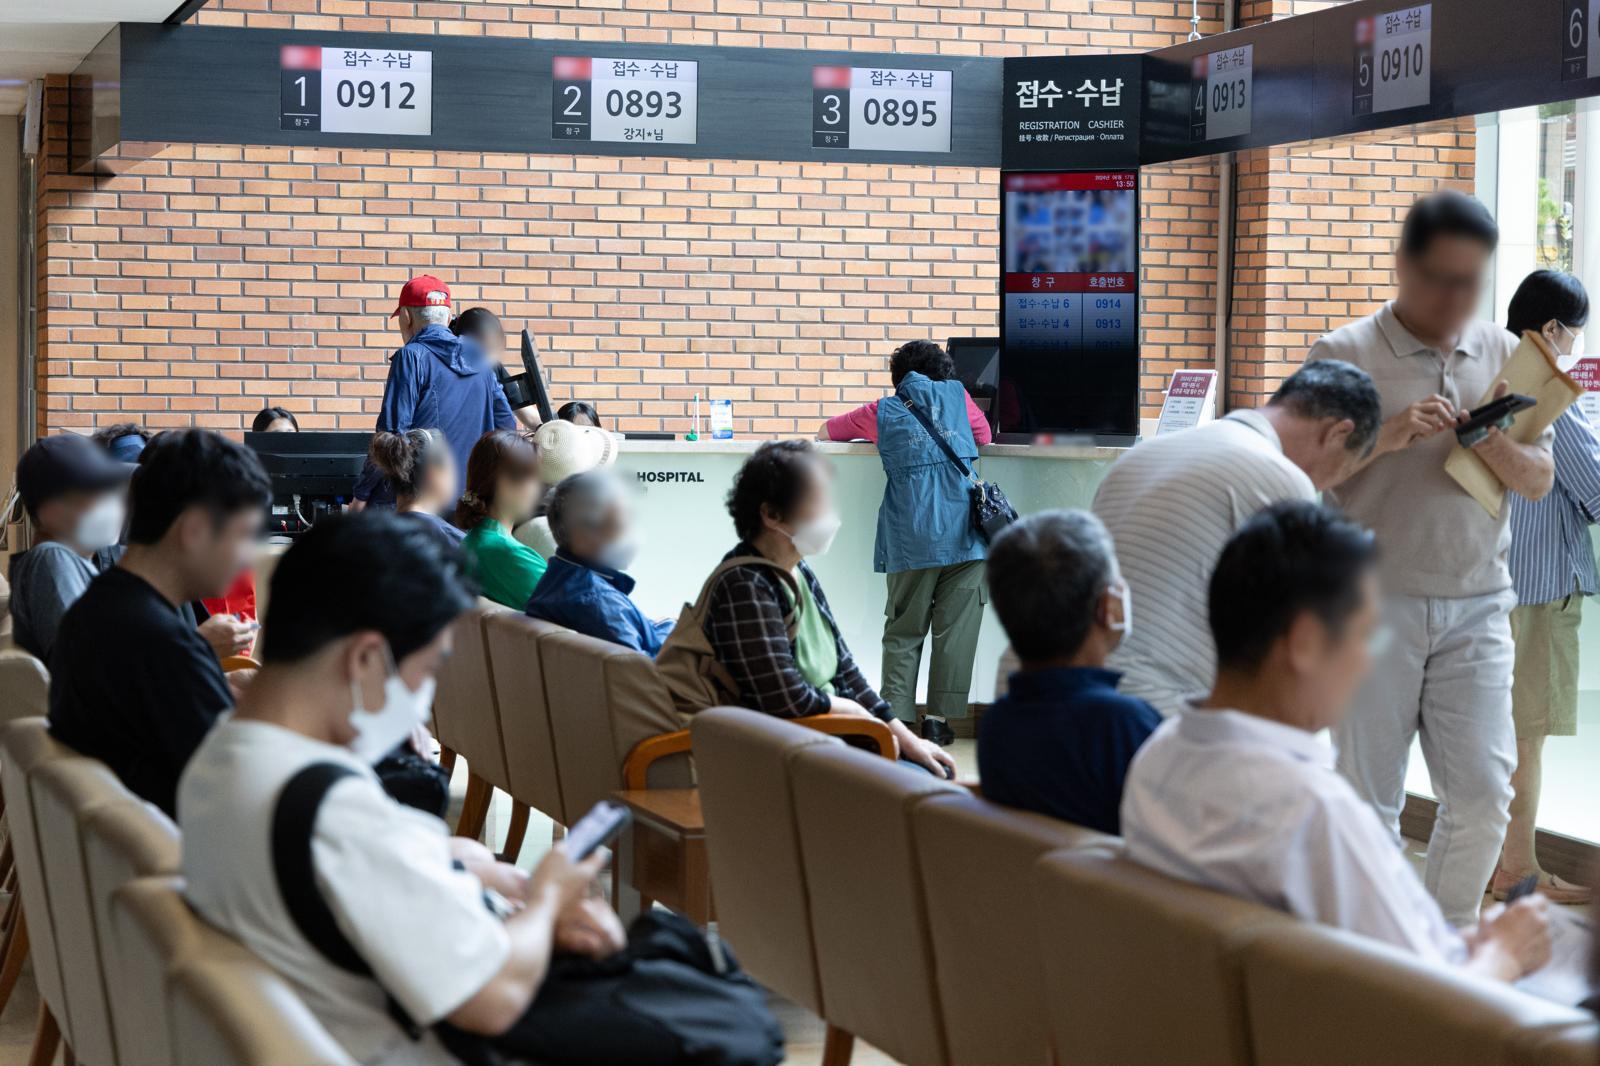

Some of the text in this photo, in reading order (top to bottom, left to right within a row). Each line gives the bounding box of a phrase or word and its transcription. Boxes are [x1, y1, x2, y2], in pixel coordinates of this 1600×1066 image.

[1385, 8, 1422, 34] 접수·수납
[1569, 8, 1583, 49] 6
[343, 50, 413, 69] 접수·수납
[612, 60, 679, 79] 접수·수납
[1216, 48, 1245, 70] 접수·수납
[1359, 51, 1369, 86] 5
[1381, 43, 1423, 82] 0910
[294, 76, 306, 107] 1
[870, 70, 934, 88] 접수·수납
[336, 79, 416, 110] 0912
[563, 85, 582, 116] 2
[606, 89, 682, 119] 0893
[1016, 78, 1125, 108] 접수·수납
[1195, 84, 1204, 116] 4
[1213, 78, 1246, 113] 0913
[822, 94, 841, 125] 3
[863, 98, 937, 127] 0895
[1019, 120, 1124, 130] REGISTRATION CASHIER
[1054, 134, 1095, 142] Регистрация
[1089, 277, 1125, 288] 호출번호
[1018, 299, 1070, 310] 접수·수납 6
[1095, 299, 1121, 309] 0914
[1063, 320, 1070, 329] 4
[1095, 319, 1121, 329] 0913
[637, 471, 704, 483] HOSPITAL
